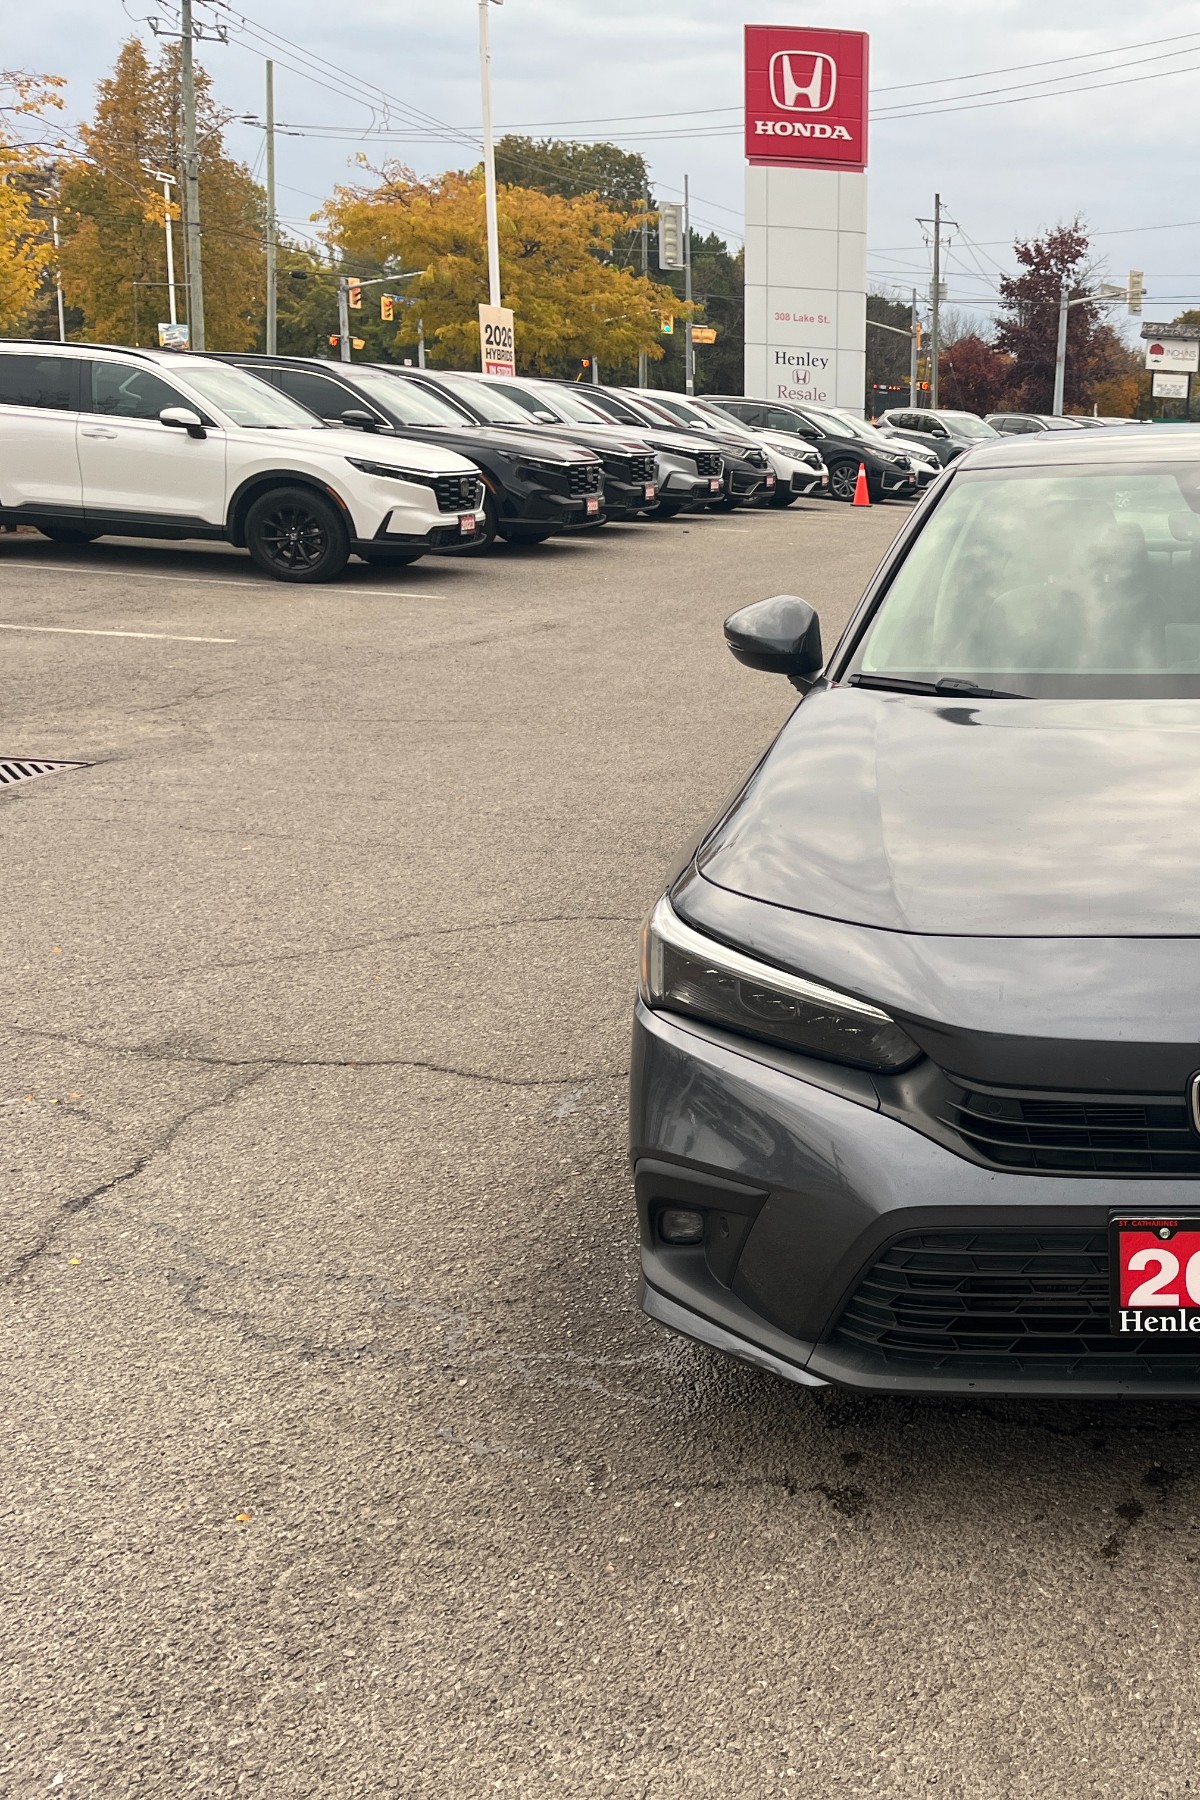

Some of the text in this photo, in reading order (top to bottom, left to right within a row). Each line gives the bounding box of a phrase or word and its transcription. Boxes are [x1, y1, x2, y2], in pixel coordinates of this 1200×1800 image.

[755, 120, 853, 140] HONDA
[774, 312, 830, 324] 308 Lake St.
[485, 324, 512, 348] 2026
[485, 348, 513, 362] HYBRIDS
[774, 351, 829, 370] Henley
[777, 385, 827, 401] Resale
